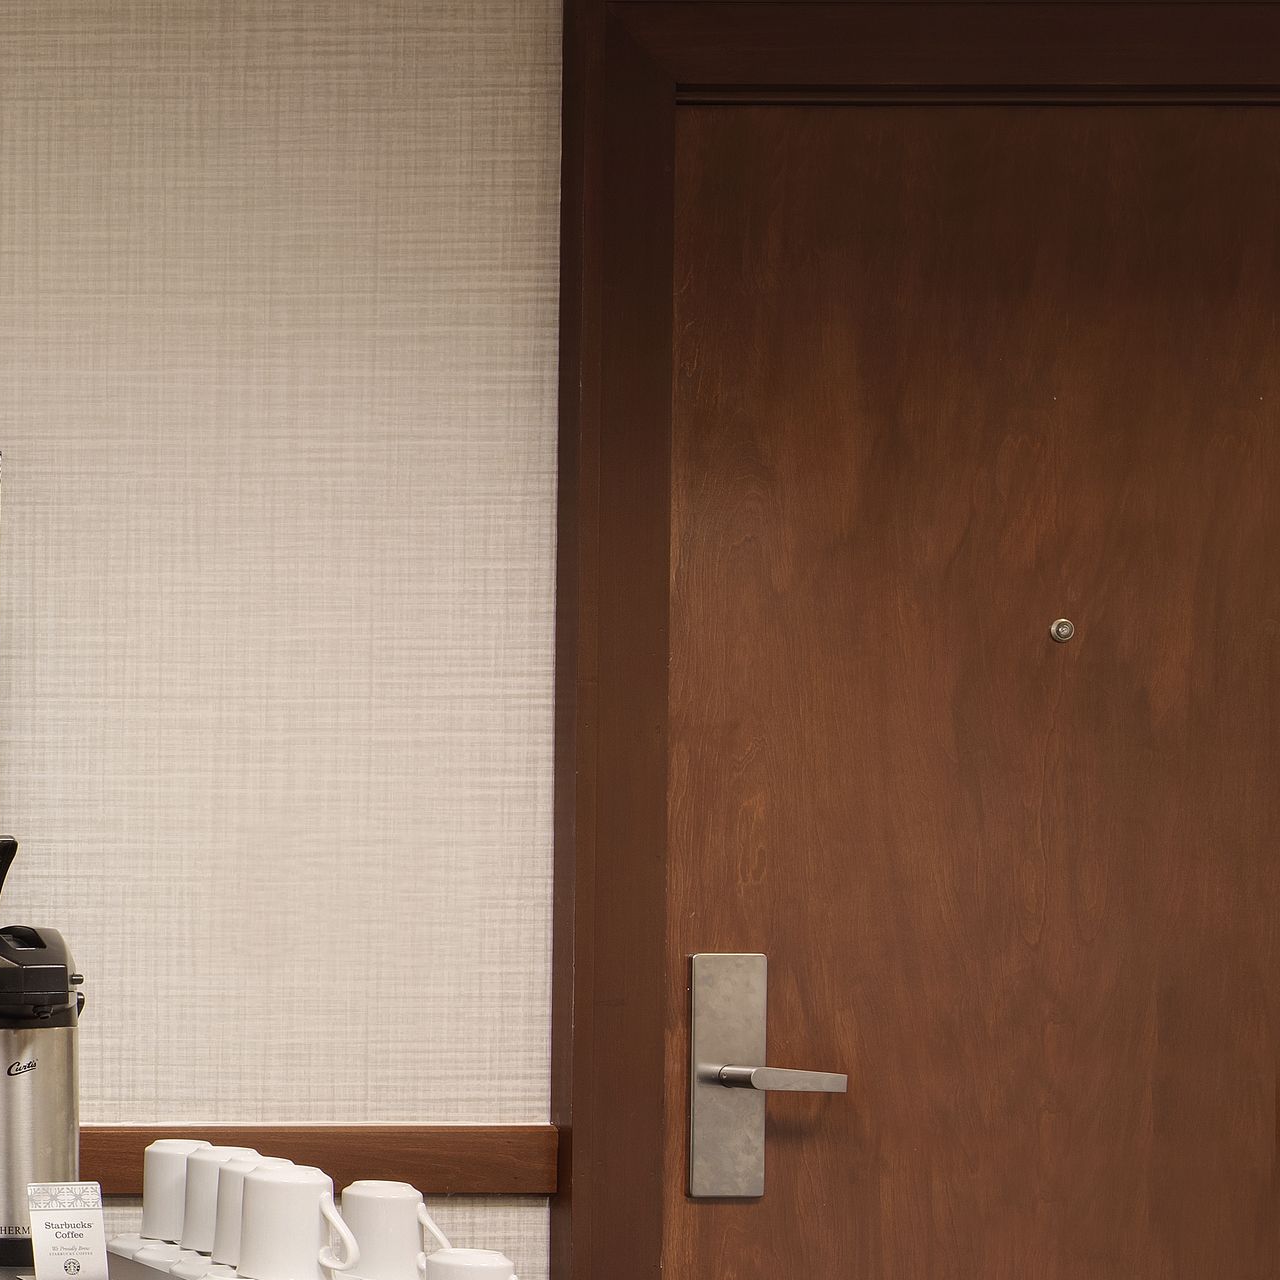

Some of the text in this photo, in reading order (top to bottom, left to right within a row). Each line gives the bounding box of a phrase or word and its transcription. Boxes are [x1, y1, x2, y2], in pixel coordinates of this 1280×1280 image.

[6, 1060, 37, 1076] Curtis
[44, 1221, 93, 1230] Starbucks
[54, 1231, 84, 1239] Coffee
